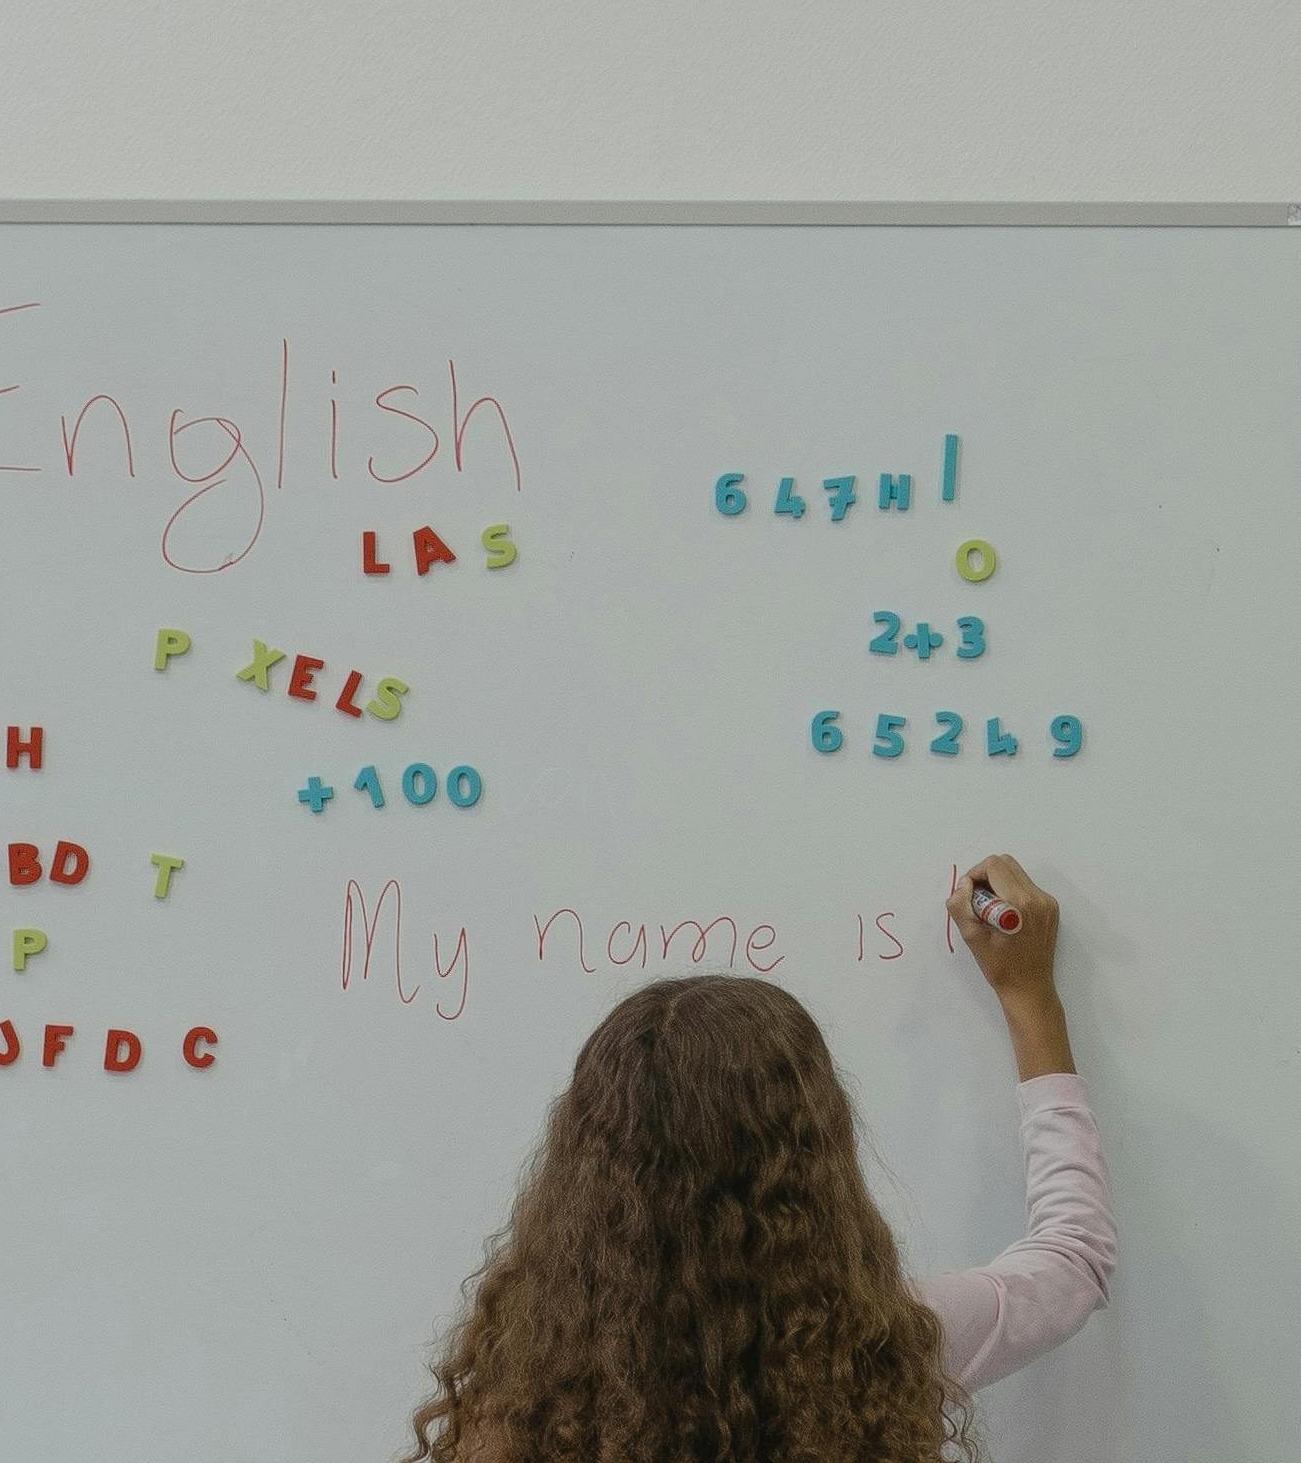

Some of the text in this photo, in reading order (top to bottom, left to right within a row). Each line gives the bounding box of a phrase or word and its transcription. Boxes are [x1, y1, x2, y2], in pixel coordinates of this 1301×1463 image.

[361, 524, 519, 578] LAS
[342, 879, 903, 1020] My name is
